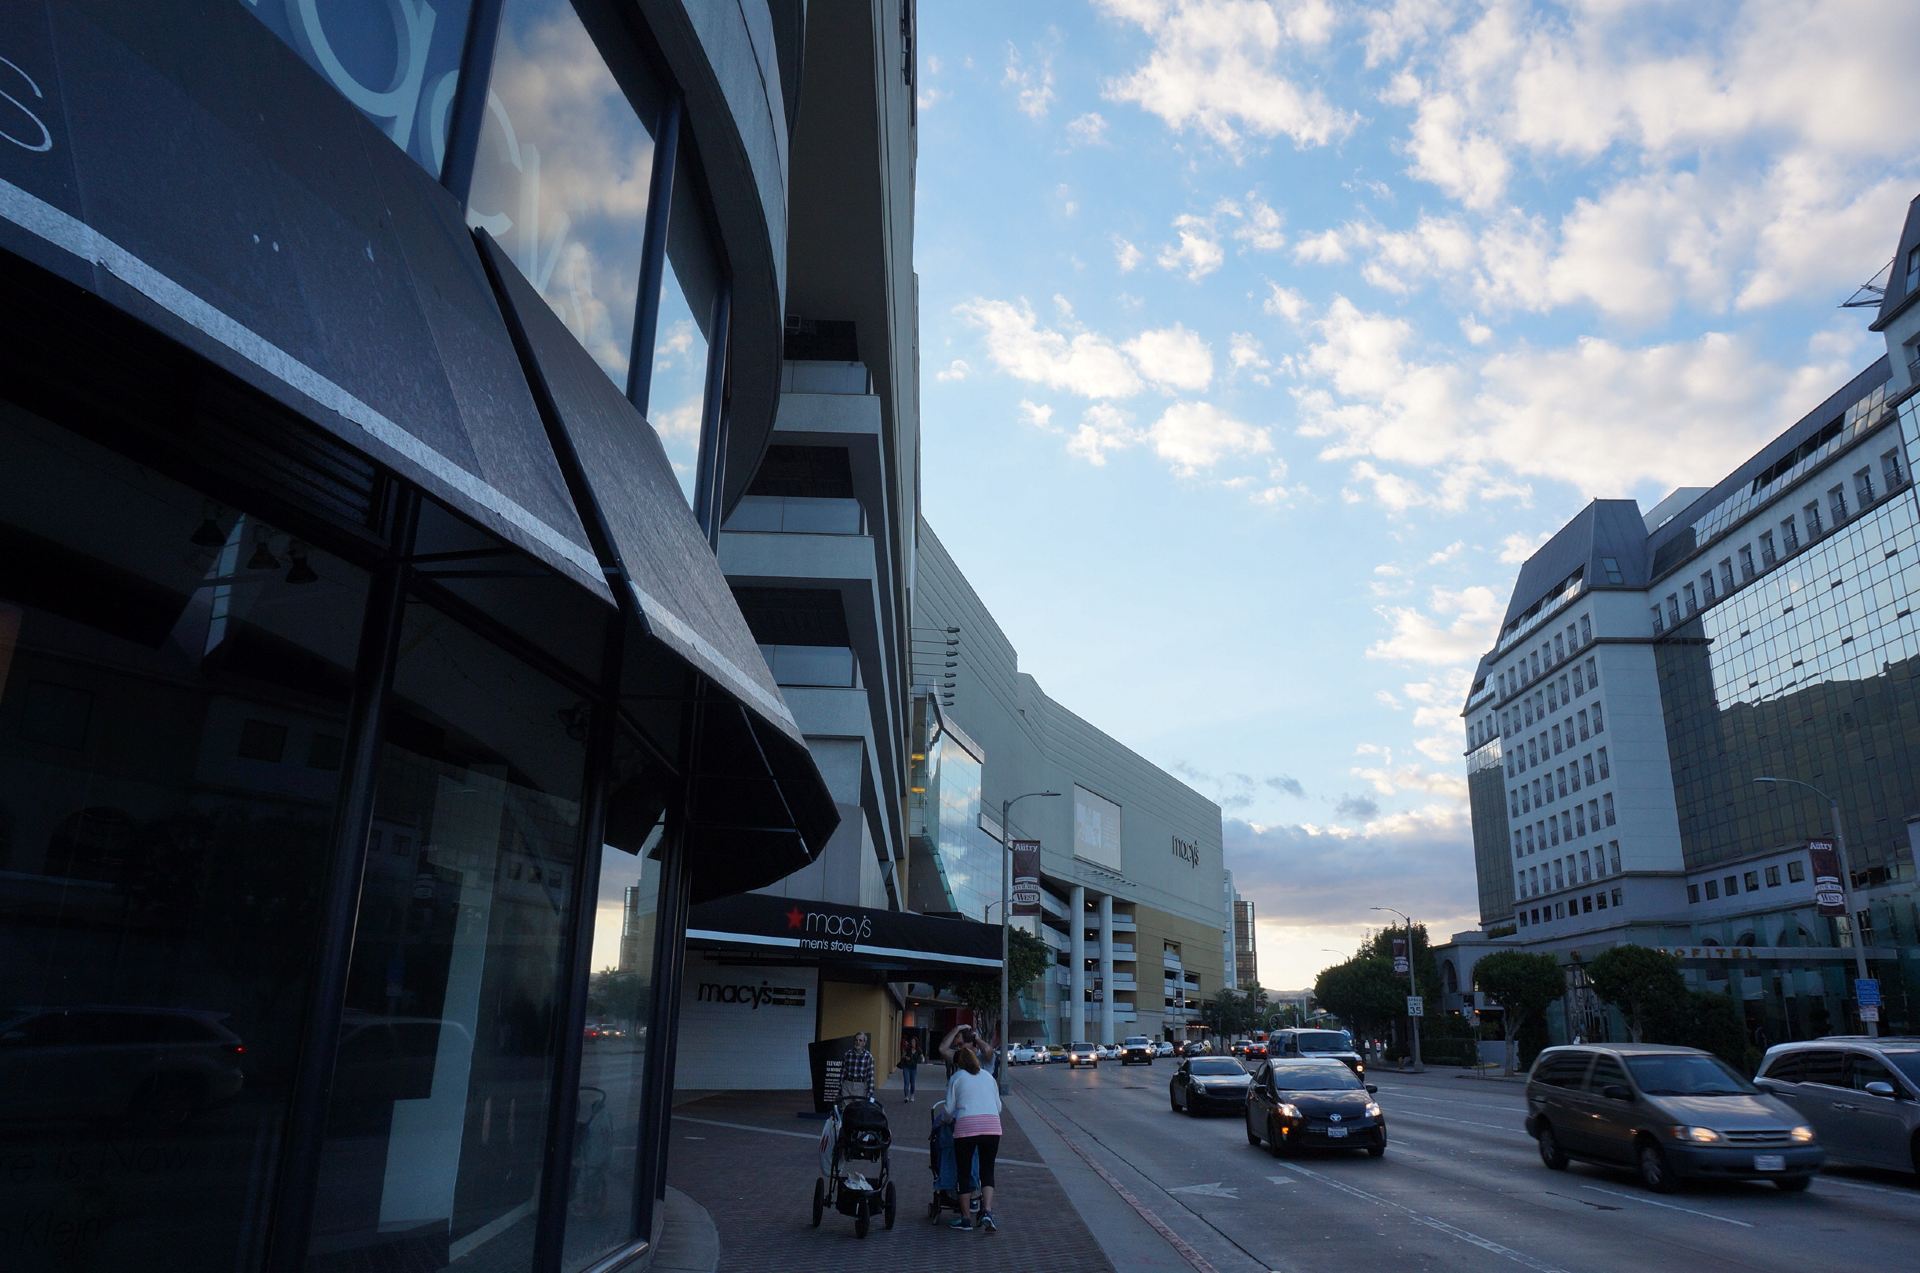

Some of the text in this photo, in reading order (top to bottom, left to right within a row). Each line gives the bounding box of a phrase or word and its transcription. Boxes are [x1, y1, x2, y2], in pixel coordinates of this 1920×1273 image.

[1014, 843, 1038, 853] Autry
[1172, 835, 1200, 869] macy's
[1810, 841, 1833, 851] Autry
[806, 912, 872, 942] macy's
[801, 938, 853, 953] men's store
[697, 981, 772, 1009] macy's
[1409, 1006, 1422, 1015] 35
